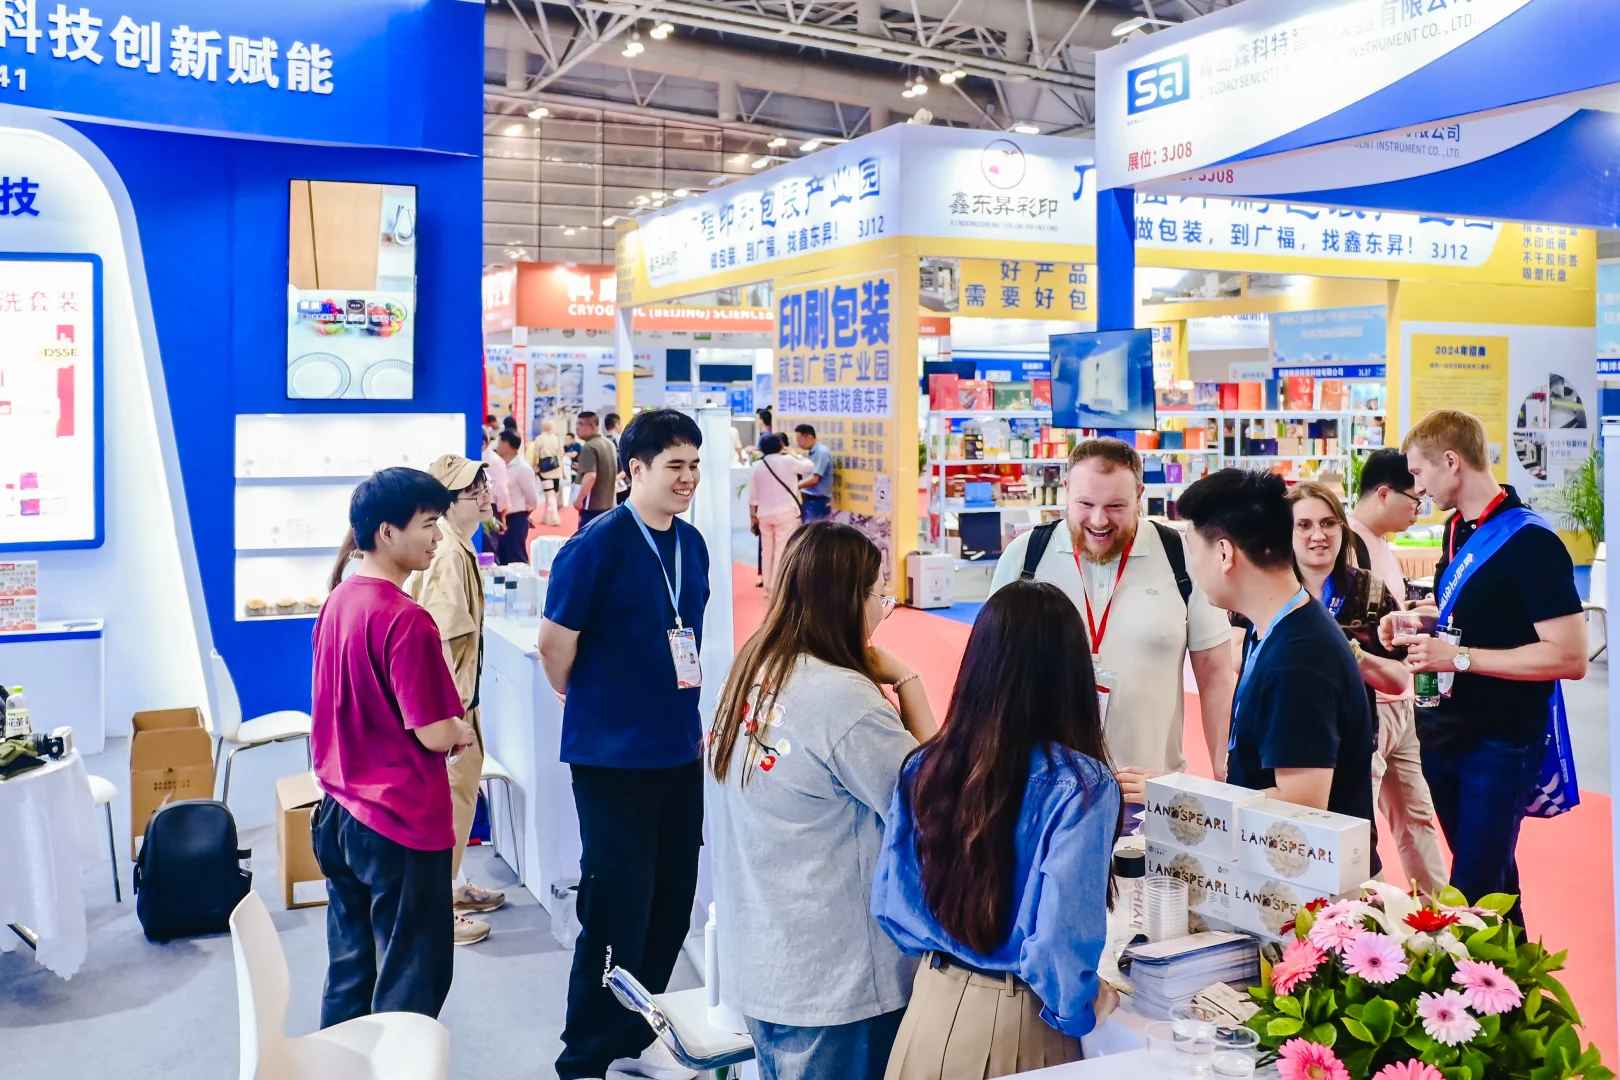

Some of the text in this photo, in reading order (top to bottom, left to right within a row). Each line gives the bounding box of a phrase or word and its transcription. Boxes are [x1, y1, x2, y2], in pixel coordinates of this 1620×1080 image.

[0, 0, 334, 95] 科技创新赋能
[1161, 141, 1193, 163] 3J08
[1376, 140, 1427, 155] INSTRUMENT
[1431, 242, 1468, 260] 3J12
[778, 278, 891, 352] 印刷包装
[778, 349, 890, 384] 就到广福产业园
[777, 387, 889, 415] 塑料软包装就找鑫东昇
